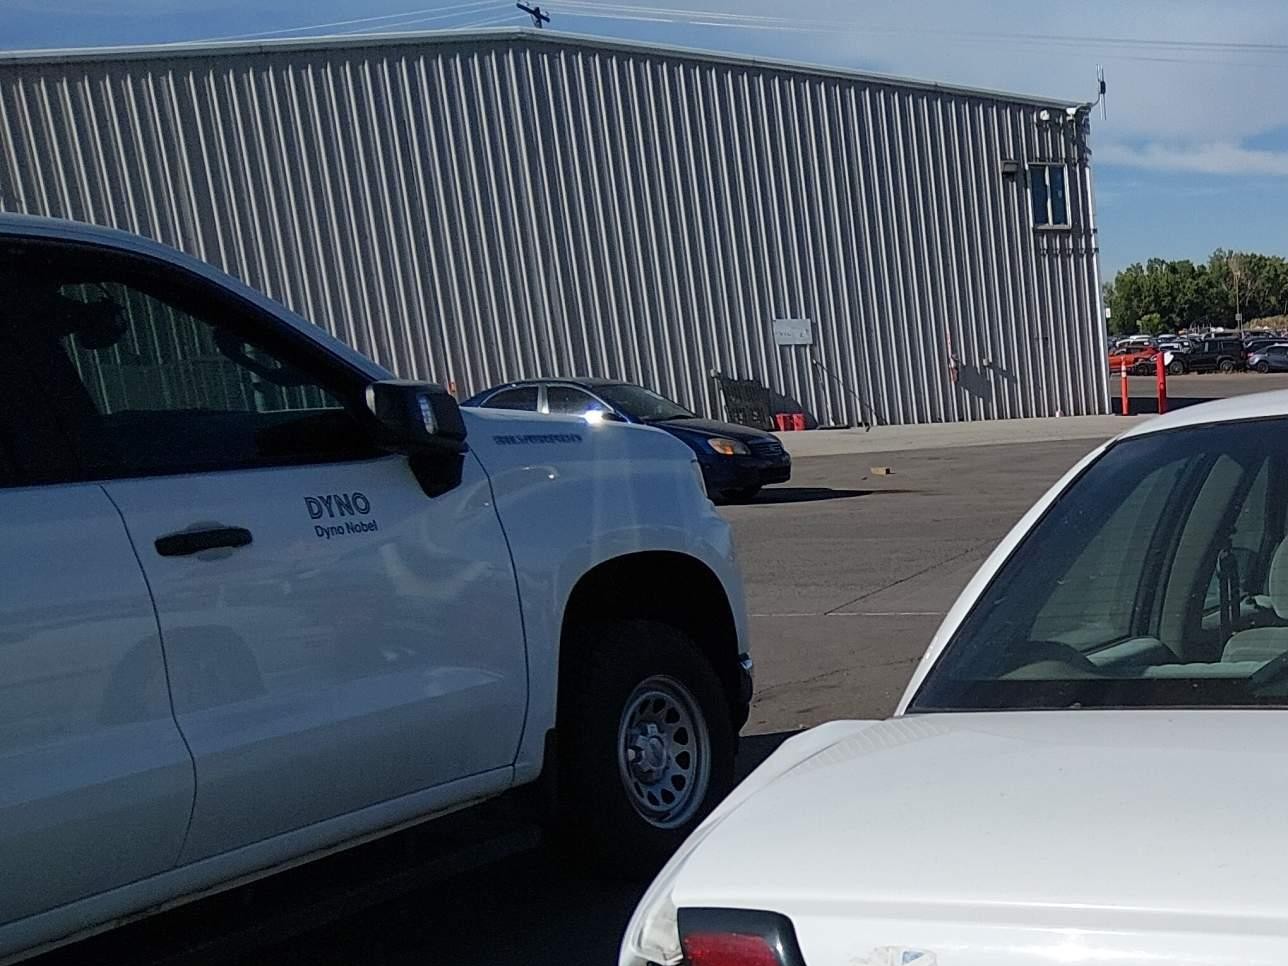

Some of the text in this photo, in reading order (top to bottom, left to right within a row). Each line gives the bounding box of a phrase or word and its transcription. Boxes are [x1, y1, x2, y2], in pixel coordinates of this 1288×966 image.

[304, 492, 370, 519] DYNO
[314, 520, 378, 539] Dyno Nobel
